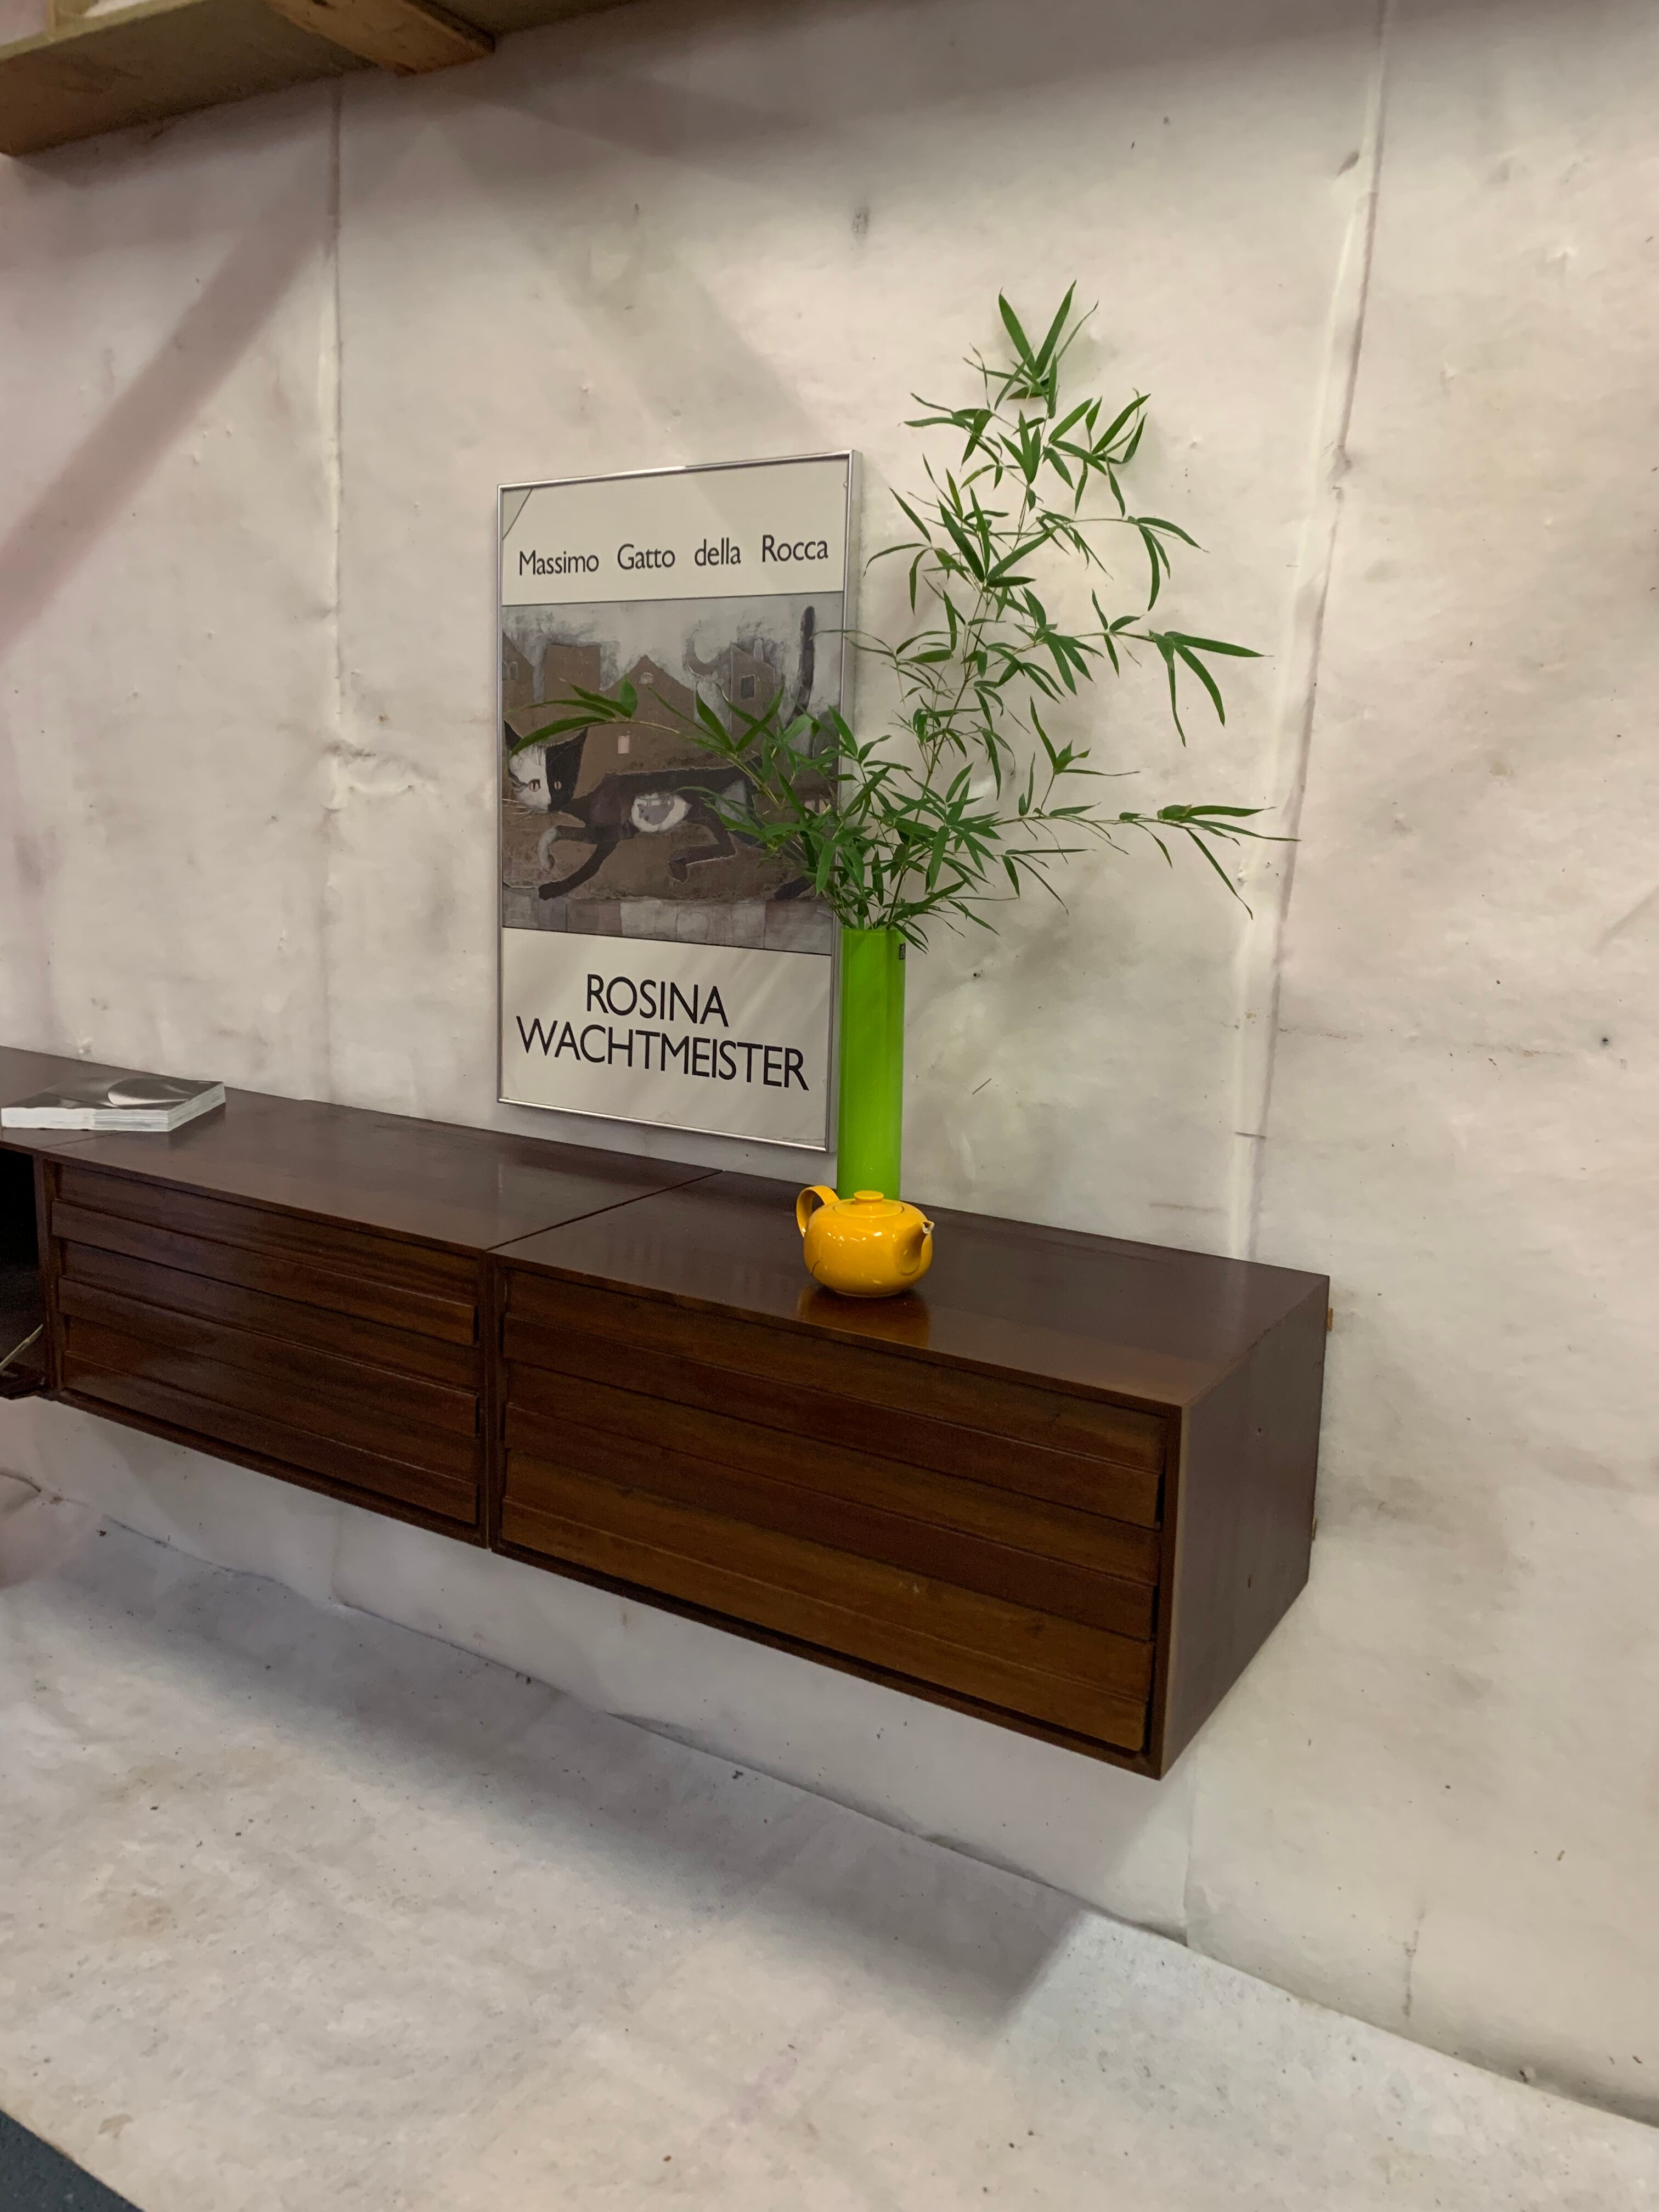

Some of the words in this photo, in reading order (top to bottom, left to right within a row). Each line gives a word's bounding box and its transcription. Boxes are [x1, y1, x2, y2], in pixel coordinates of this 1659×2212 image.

[519, 550, 600, 576] Massimo
[617, 543, 675, 570] Gatto
[694, 537, 741, 567] della
[761, 534, 828, 563] Rocca
[586, 973, 729, 1028] ROSINA
[516, 1015, 809, 1091] WACHTMEISTER
